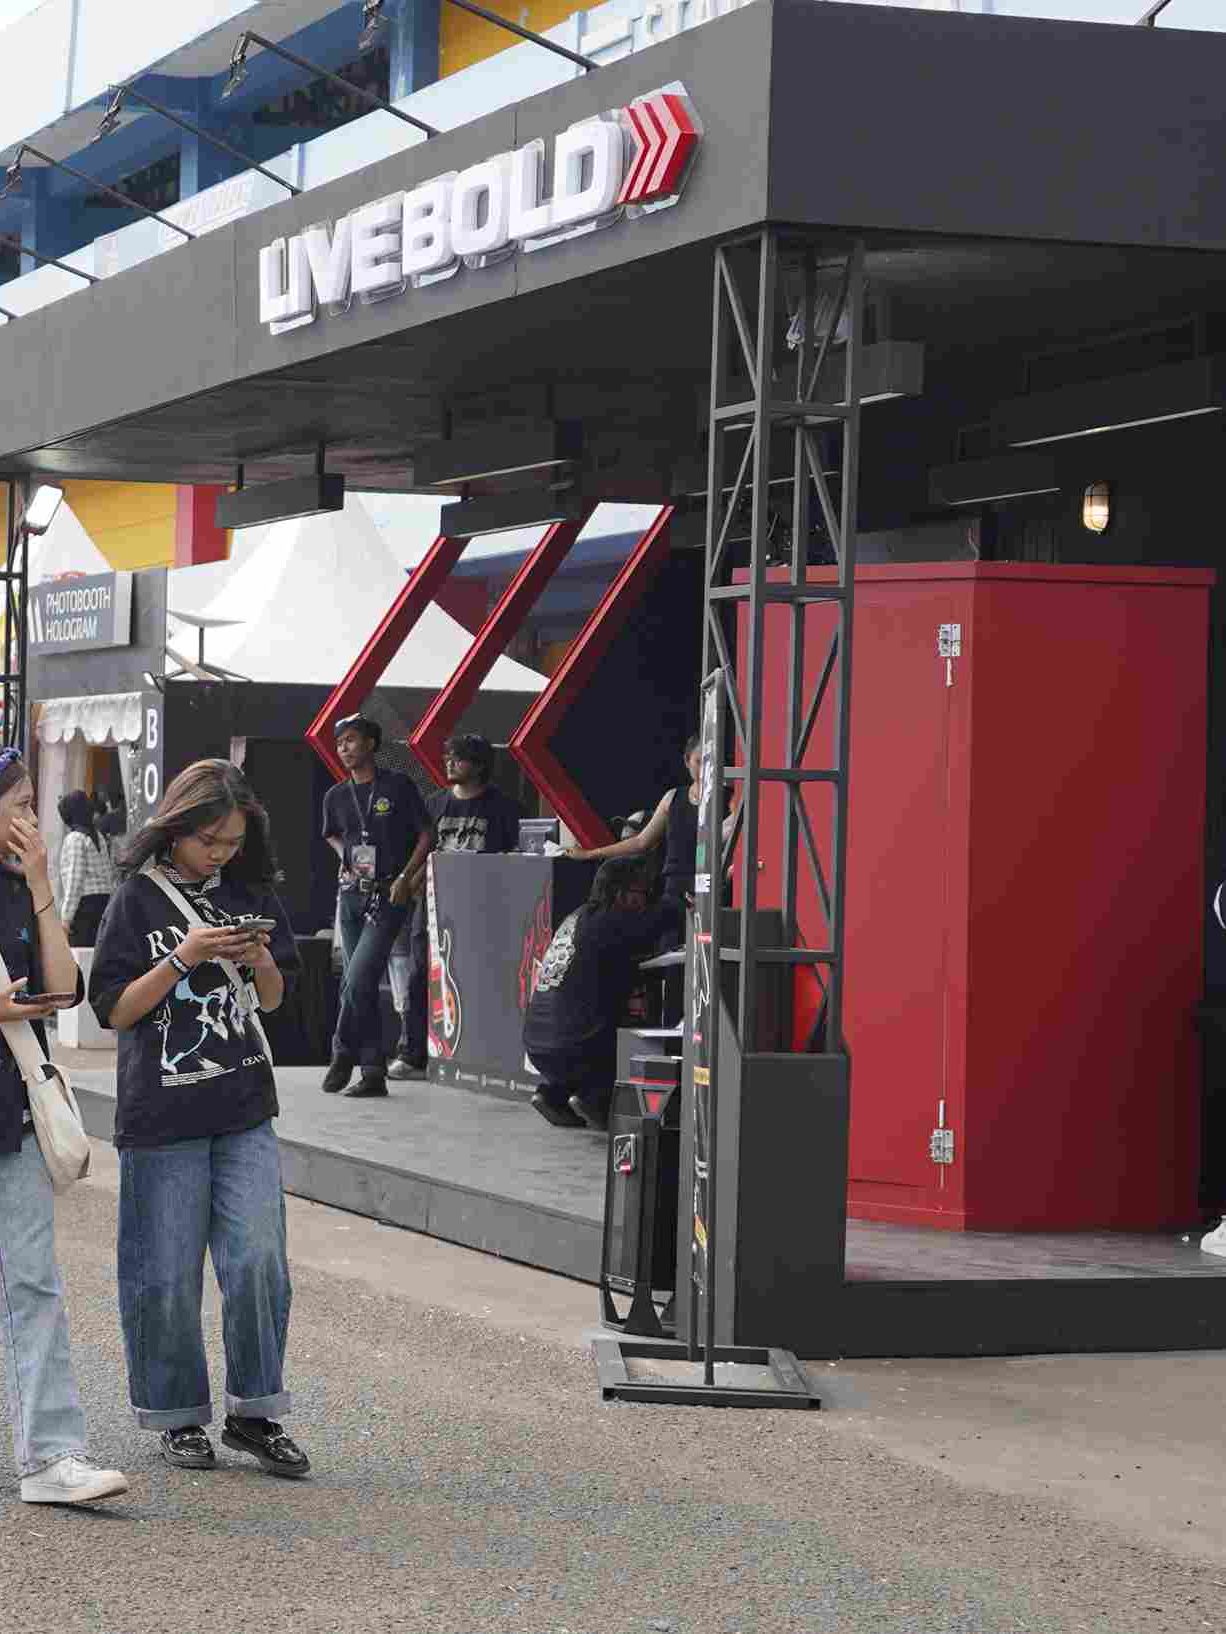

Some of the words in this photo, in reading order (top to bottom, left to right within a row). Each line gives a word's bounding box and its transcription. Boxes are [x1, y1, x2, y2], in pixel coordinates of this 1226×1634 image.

[259, 117, 623, 324] LIVEBOLD
[45, 586, 111, 615] PHOTOBOOTH
[45, 616, 98, 642] HOLOGRAM
